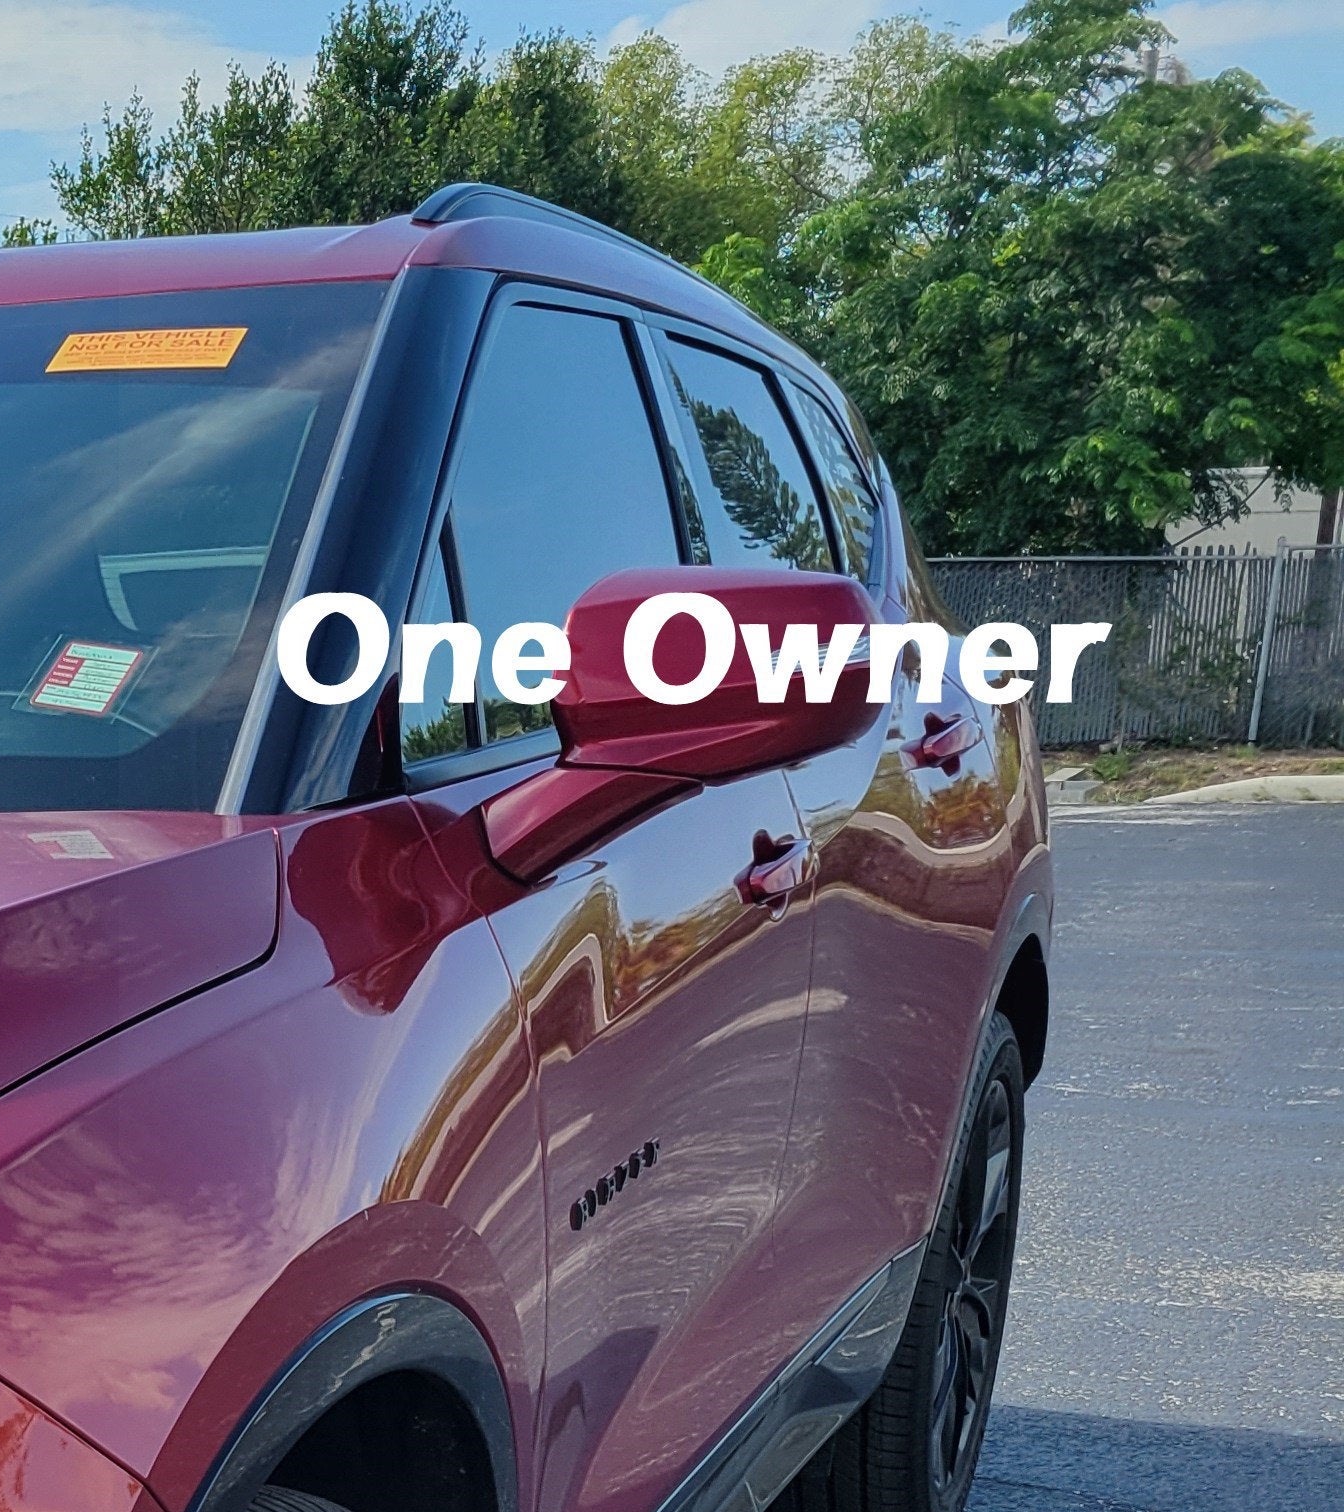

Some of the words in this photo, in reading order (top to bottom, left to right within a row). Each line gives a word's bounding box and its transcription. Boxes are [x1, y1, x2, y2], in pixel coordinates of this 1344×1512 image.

[75, 334, 126, 343] THIS
[69, 342, 108, 351] Not
[114, 340, 162, 349] FOR
[170, 338, 232, 346] SALE
